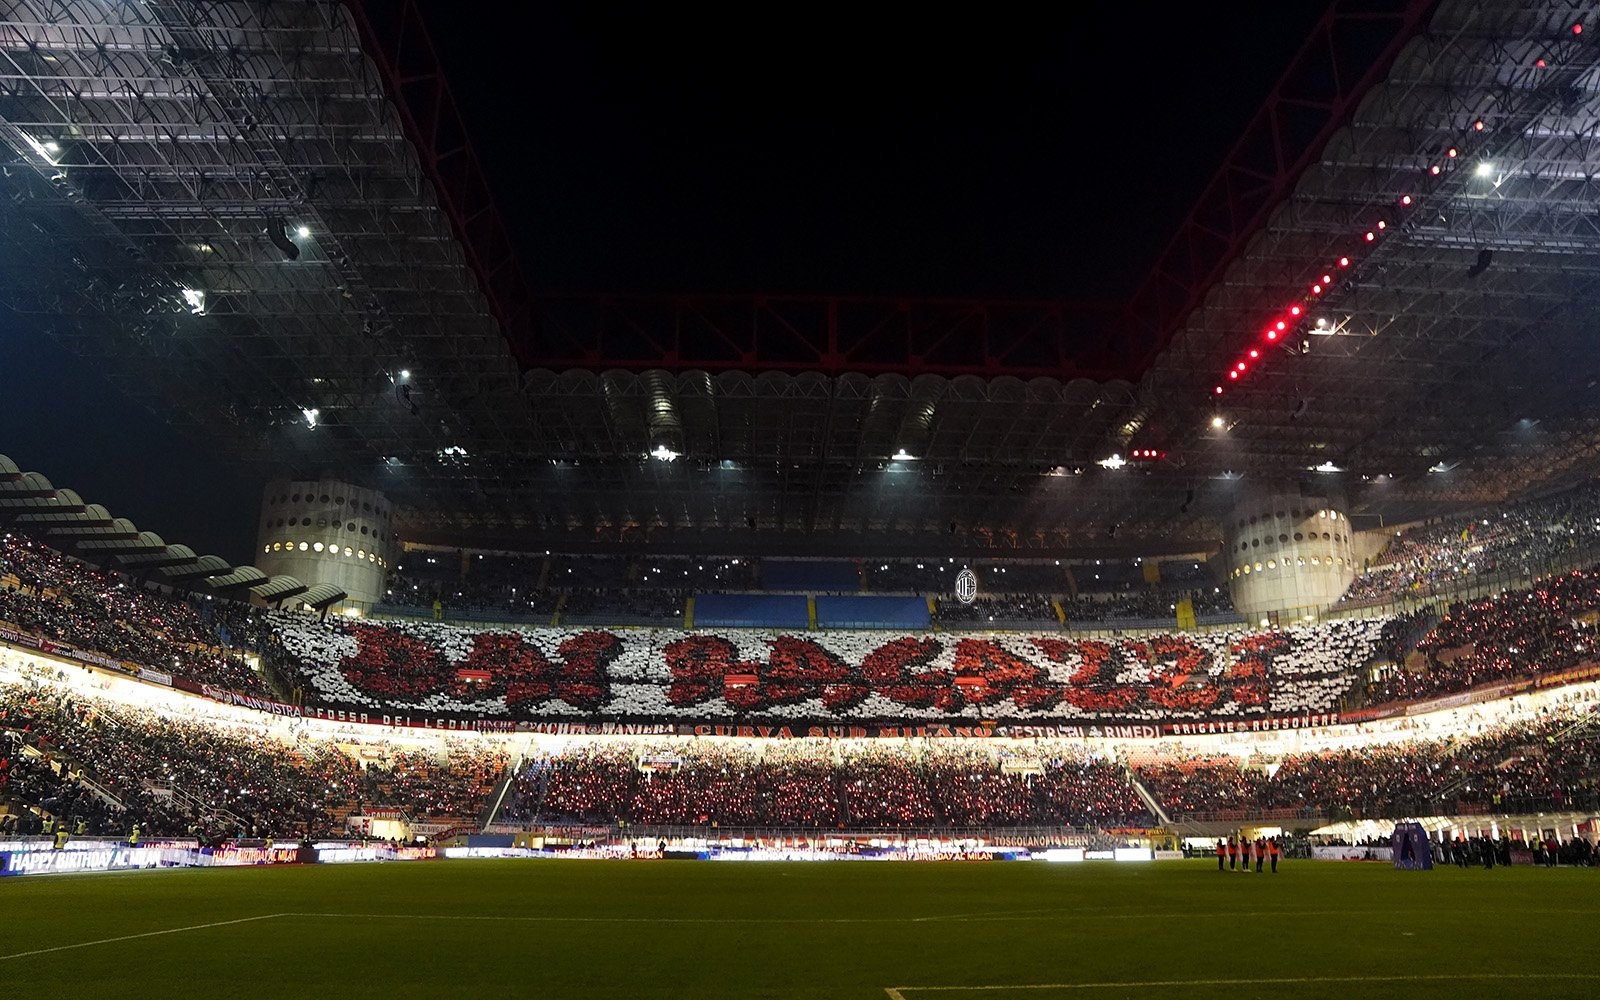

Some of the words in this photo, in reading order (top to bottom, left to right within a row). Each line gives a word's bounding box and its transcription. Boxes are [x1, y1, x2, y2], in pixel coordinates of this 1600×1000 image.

[271, 702, 302, 717] ISTRA
[316, 707, 368, 723] FOSSA
[383, 715, 411, 727] DEI
[424, 718, 477, 731] LEONI
[1173, 721, 1235, 735] BRIGATE
[1252, 712, 1338, 731] ROSSONERE
[694, 725, 794, 738] CURVA
[808, 725, 867, 738] SUD
[879, 726, 994, 738] MILANO
[1104, 726, 1160, 738] RIMEDI
[9, 851, 55, 871] HAPPY
[55, 850, 113, 869] BIRTHDAY
[111, 850, 129, 867] AC
[129, 848, 161, 866] MILAN
[212, 850, 236, 863] HAPPY
[237, 850, 267, 864] BIRTHDAY
[268, 849, 277, 861] AC
[278, 849, 298, 862] MILAN
[554, 849, 581, 859] HAPPY
[582, 850, 622, 860] BIRTHDAY
[623, 850, 635, 859] AC
[636, 850, 663, 859] MILAN
[914, 852, 953, 861] BIRTHDAY
[954, 852, 966, 861] AC
[967, 852, 993, 860] MILAN
